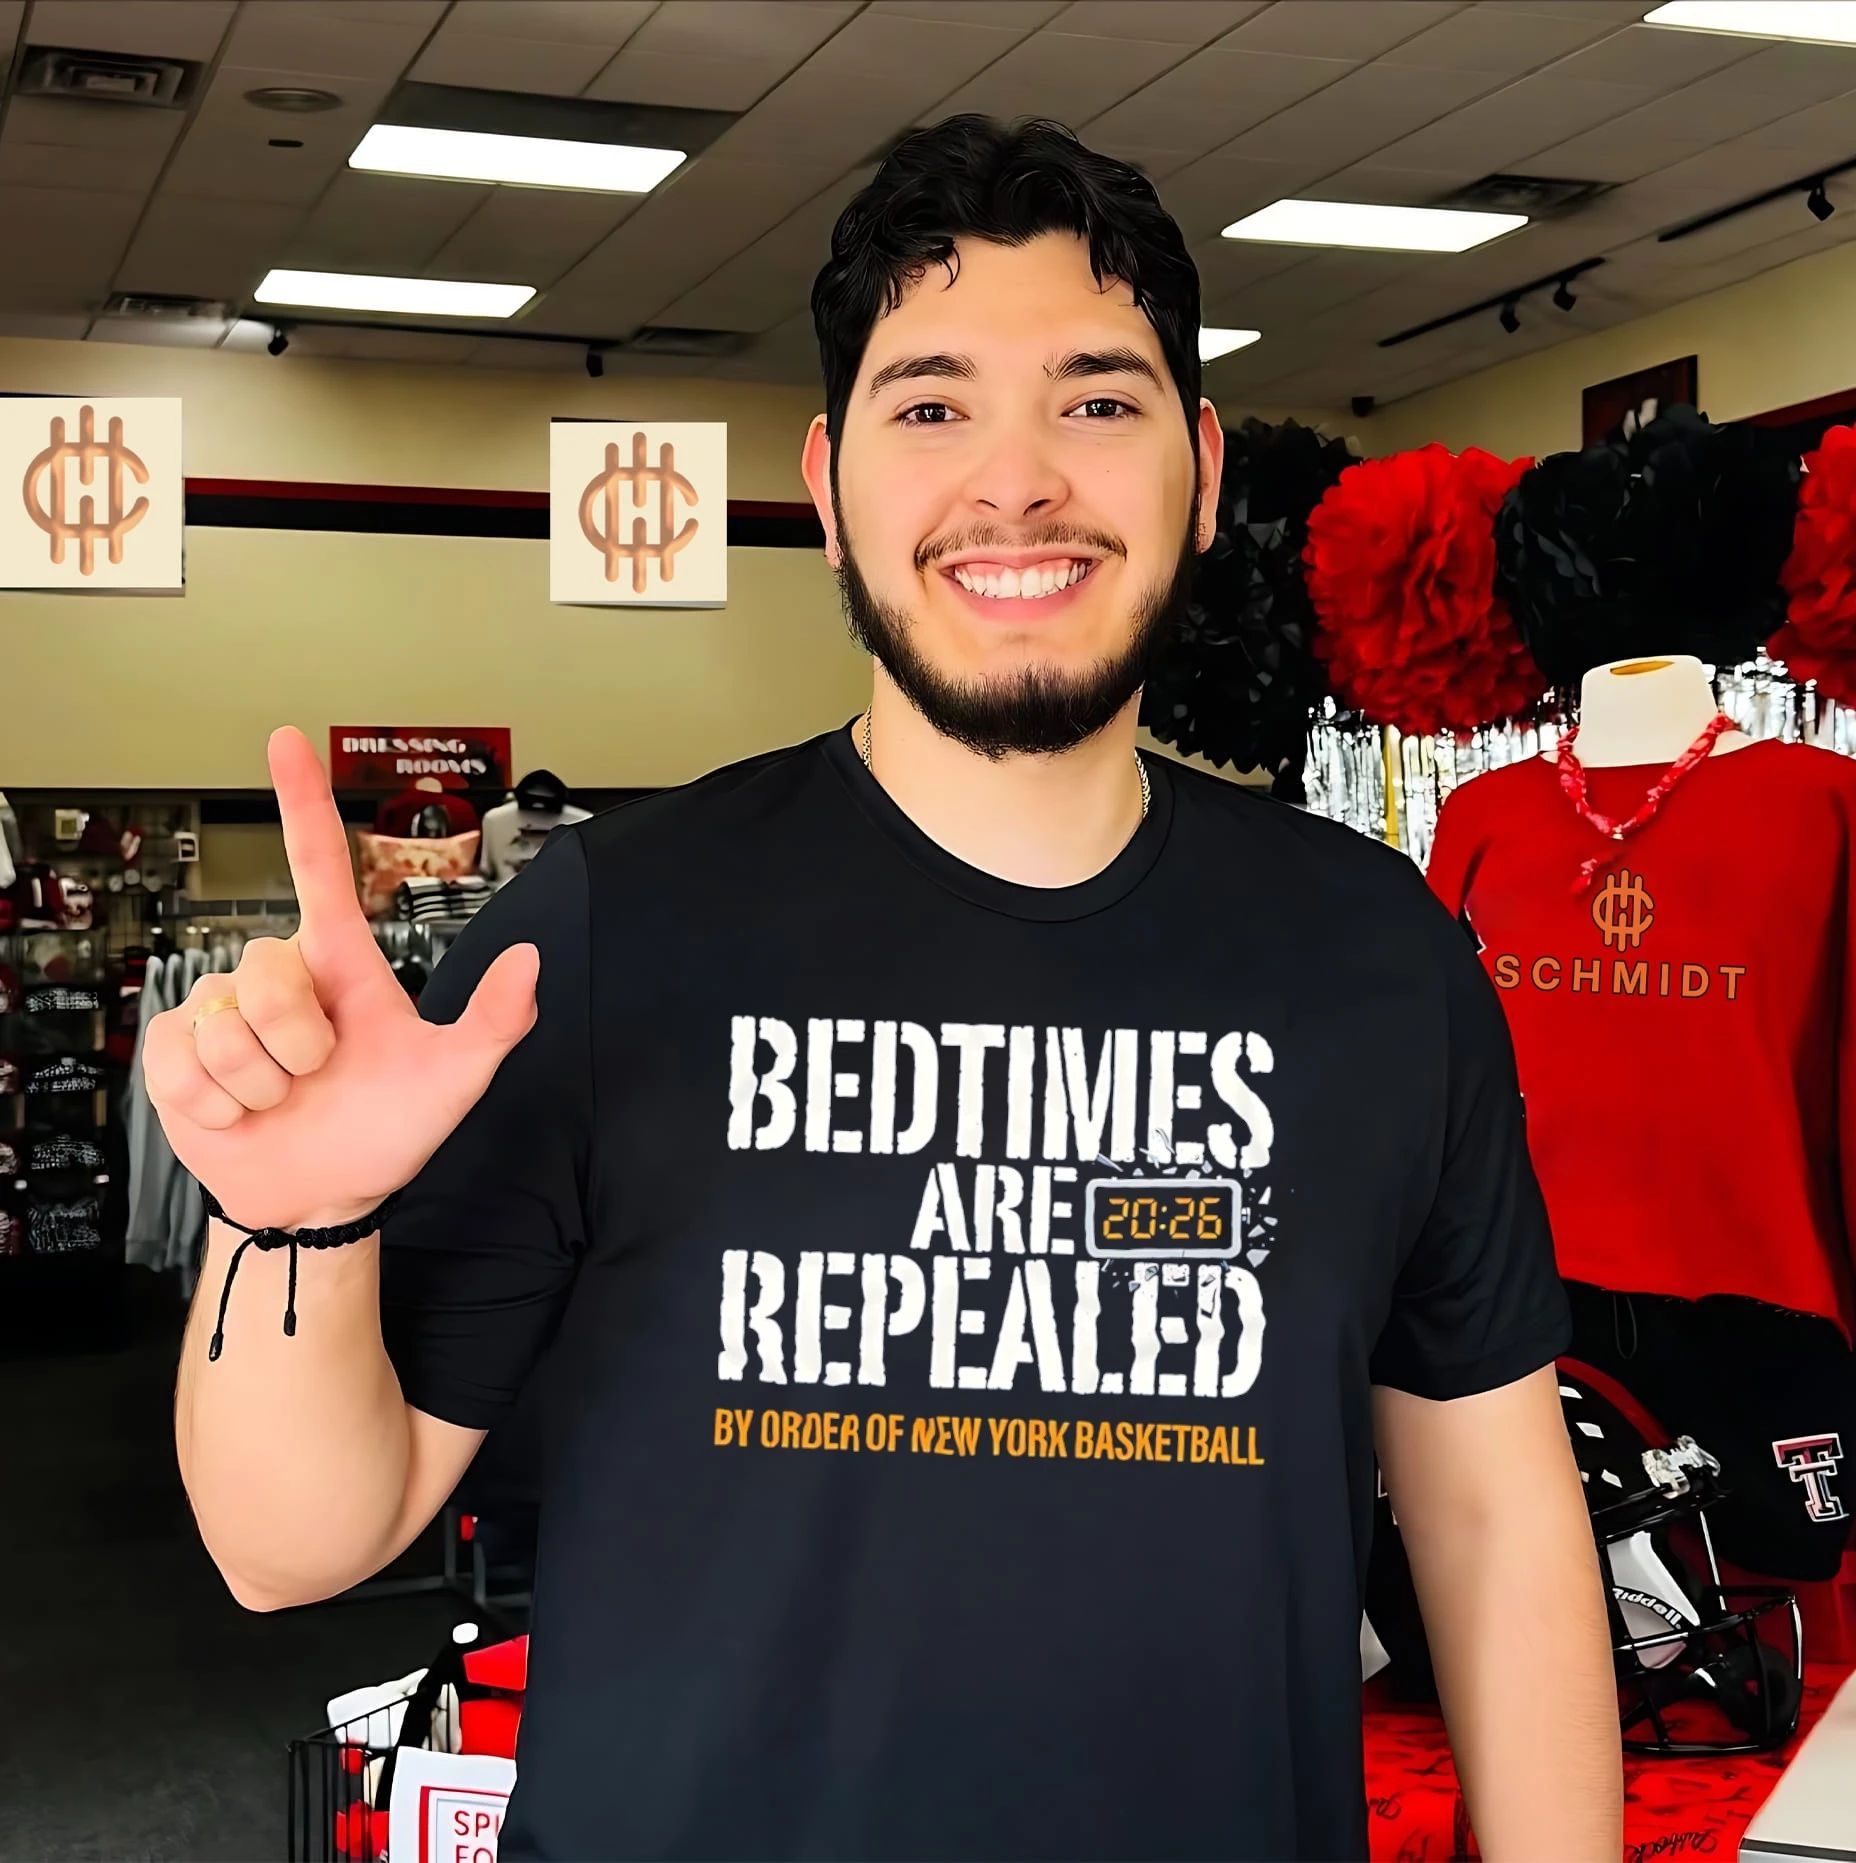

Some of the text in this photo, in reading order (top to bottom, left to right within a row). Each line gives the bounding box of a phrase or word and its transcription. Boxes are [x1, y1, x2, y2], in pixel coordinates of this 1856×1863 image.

[342, 737, 467, 754] DRESSING
[396, 758, 487, 775] ROOMS
[1494, 954, 1746, 1000] SCHMIDT
[727, 1015, 1275, 1169] BEDTIMES
[910, 1163, 1078, 1255] ARE
[1102, 1197, 1223, 1240] 20:26
[718, 1249, 1266, 1398] REPEALED
[713, 1408, 1265, 1466] BY ORDER OF NEW YORK BASKETBALL
